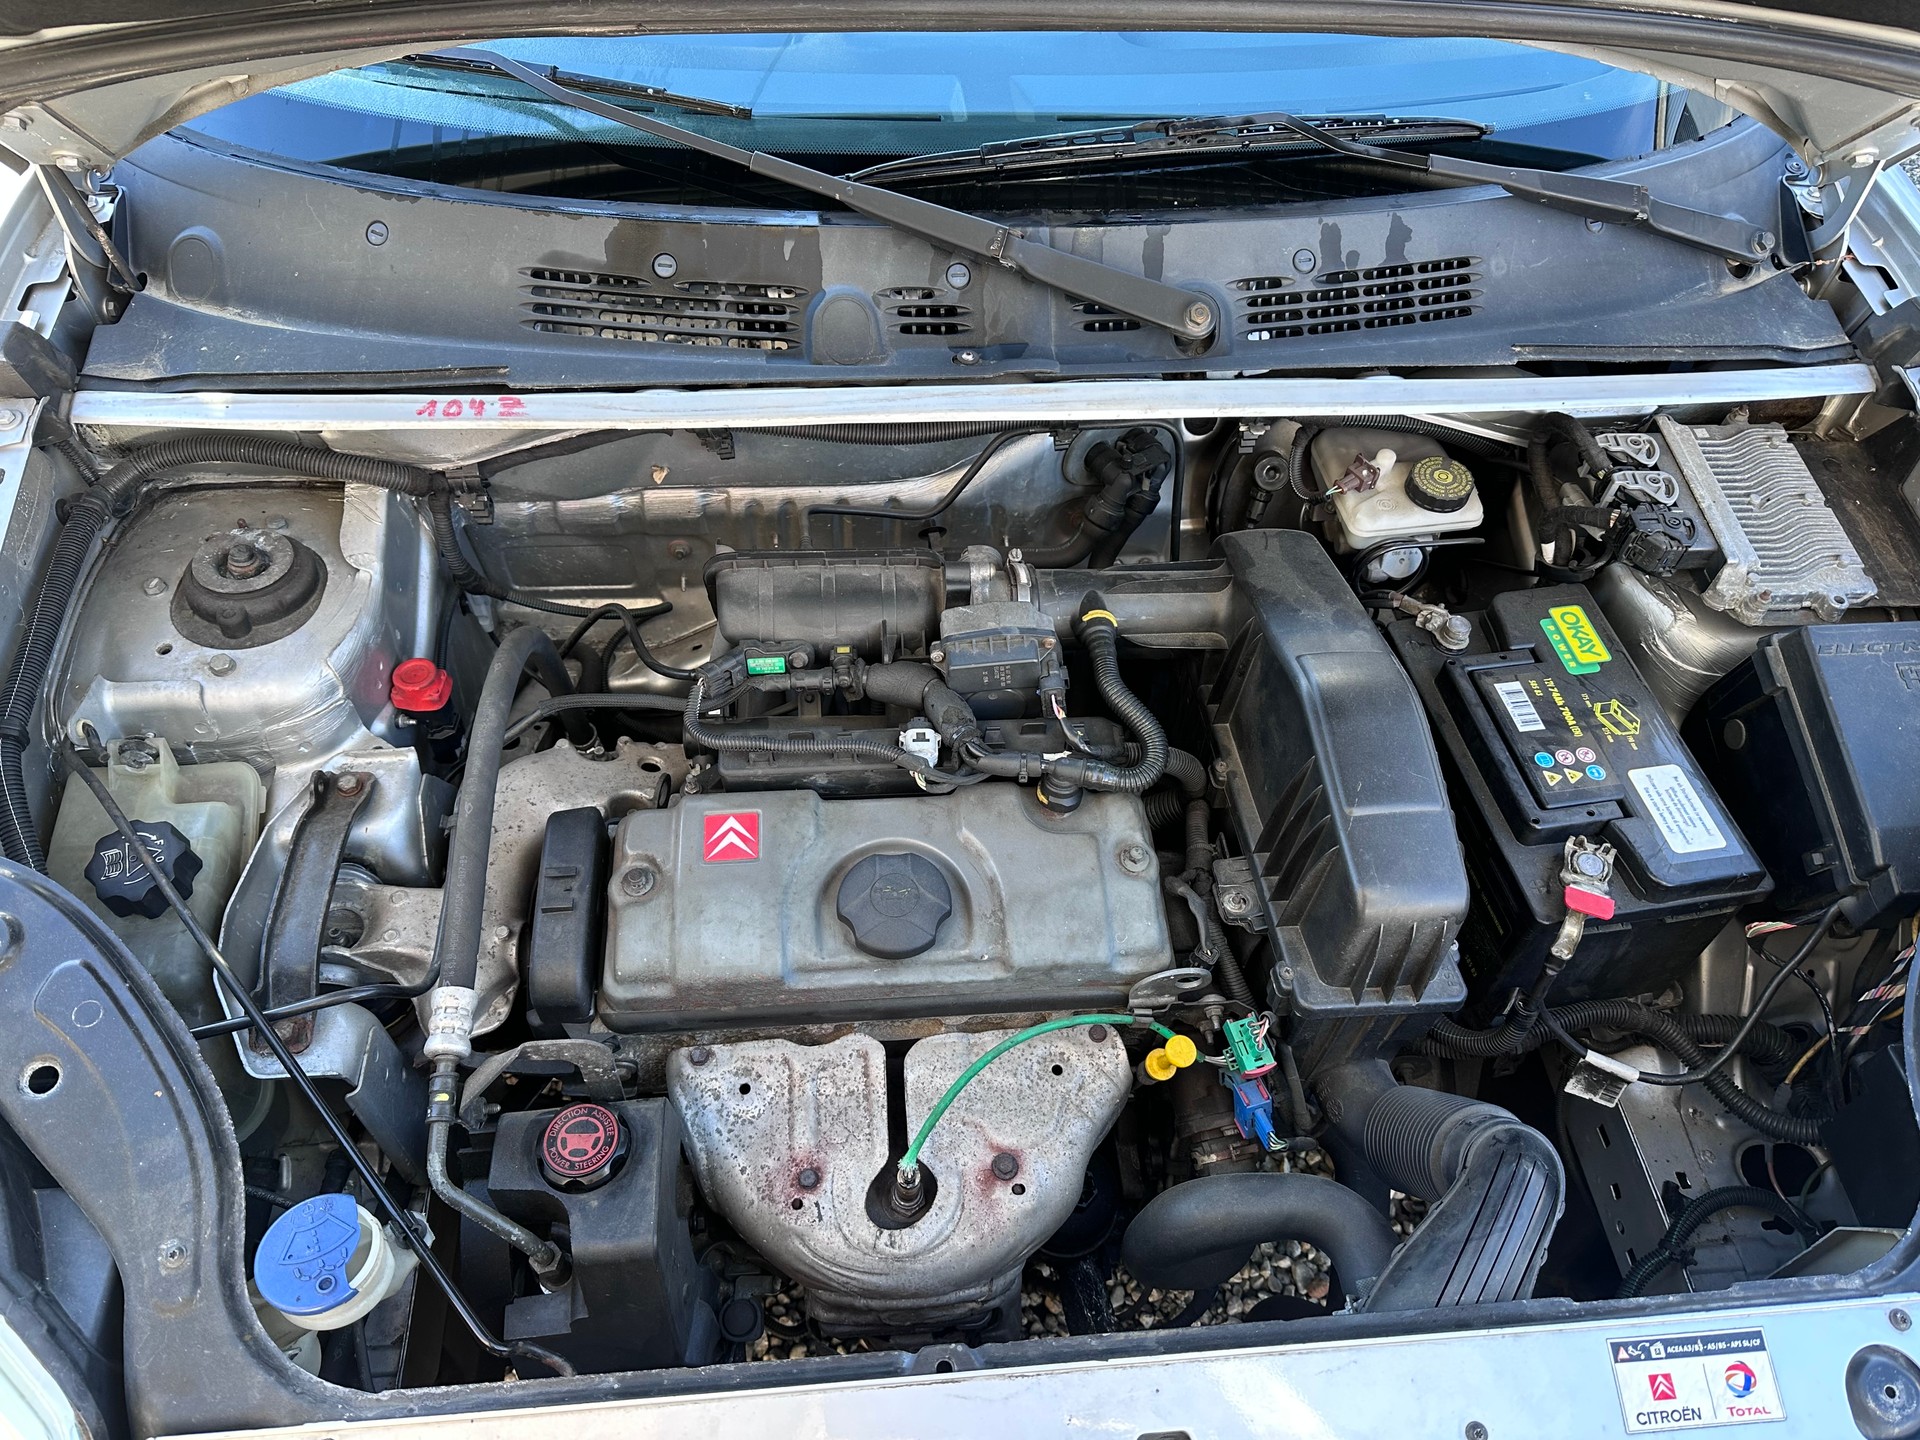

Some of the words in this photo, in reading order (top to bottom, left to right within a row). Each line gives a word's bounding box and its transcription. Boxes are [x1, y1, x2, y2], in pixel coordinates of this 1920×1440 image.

[1547, 625, 1577, 668] POWER
[1560, 611, 1602, 657] OKAY
[1560, 707, 1577, 726] 700A
[549, 1107, 589, 1137] DIRECTION
[591, 1109, 614, 1136] ASSISTEE
[549, 1146, 570, 1169] POWER
[574, 1145, 609, 1170] STEERING
[1636, 1406, 1702, 1425] CITROËN
